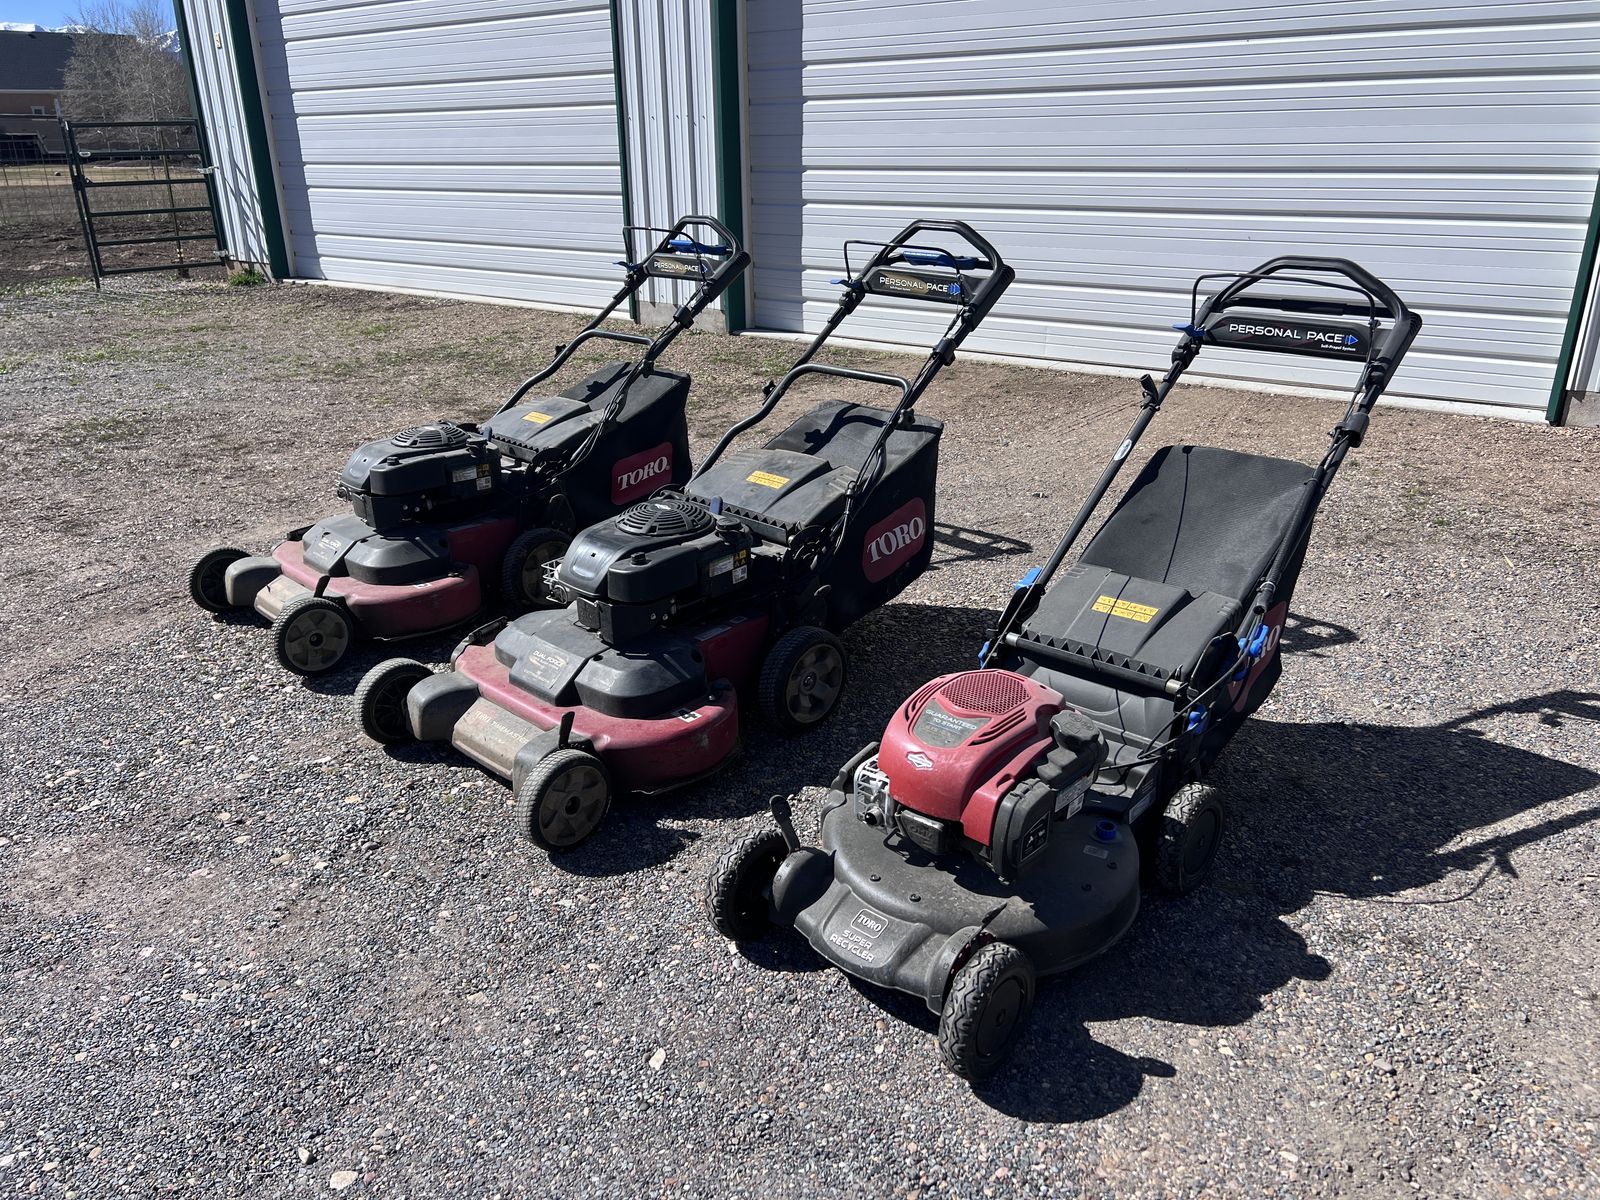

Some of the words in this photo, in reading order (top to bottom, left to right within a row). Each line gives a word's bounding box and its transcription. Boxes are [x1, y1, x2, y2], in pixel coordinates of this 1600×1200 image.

[684, 264, 699, 272] PACE
[879, 276, 923, 289] PERSONAL
[926, 282, 949, 293] PACE
[1229, 323, 1302, 339] PERSONAL
[1306, 331, 1344, 344] PACE
[617, 456, 668, 491] TORO
[866, 516, 924, 564] TORO
[925, 708, 978, 730] GUARANTEED
[932, 717, 942, 725] TO
[942, 720, 963, 731] START
[857, 914, 882, 932] TORO
[829, 933, 875, 963] RECYCLER
[842, 929, 873, 950] SUPER
